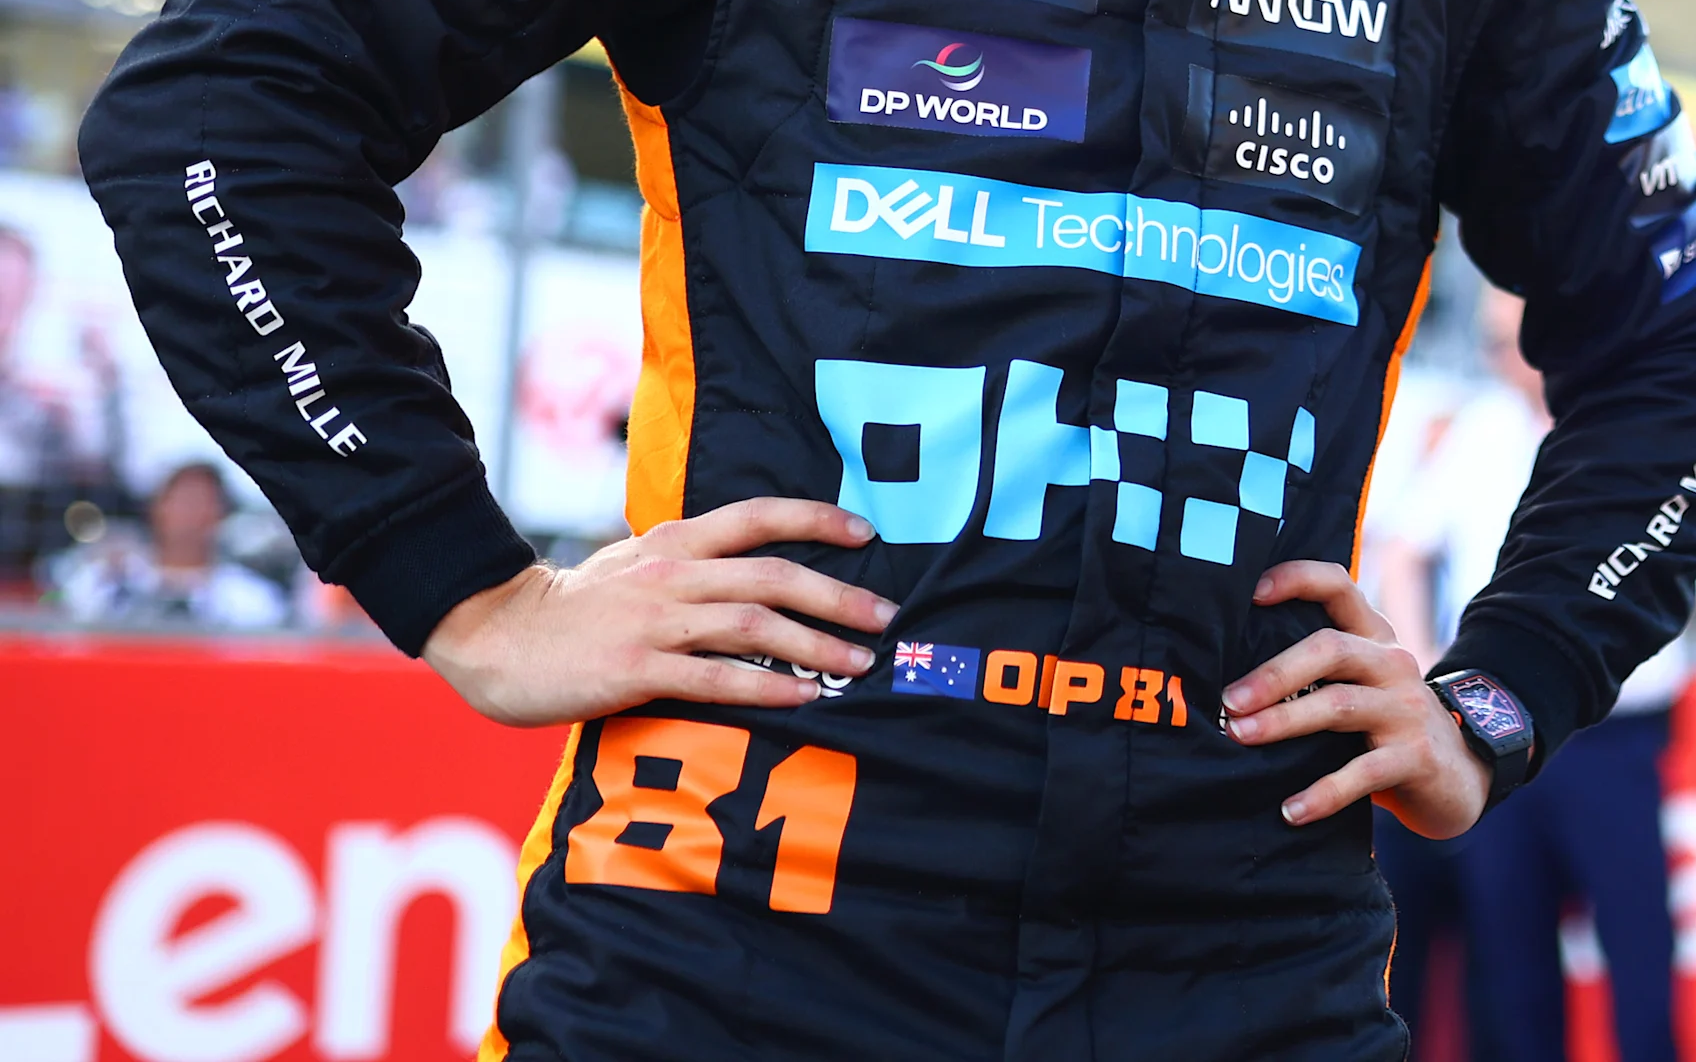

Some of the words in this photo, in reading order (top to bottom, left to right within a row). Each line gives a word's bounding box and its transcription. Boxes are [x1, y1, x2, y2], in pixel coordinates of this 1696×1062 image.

[859, 88, 910, 115] DP
[915, 94, 1048, 131] WORLD
[829, 176, 1006, 249] DELL
[1022, 196, 1345, 303] Technologies
[184, 158, 285, 337] RICHARD
[273, 340, 367, 458] MILLE
[1113, 666, 1188, 727] 81
[564, 716, 857, 915] 81
